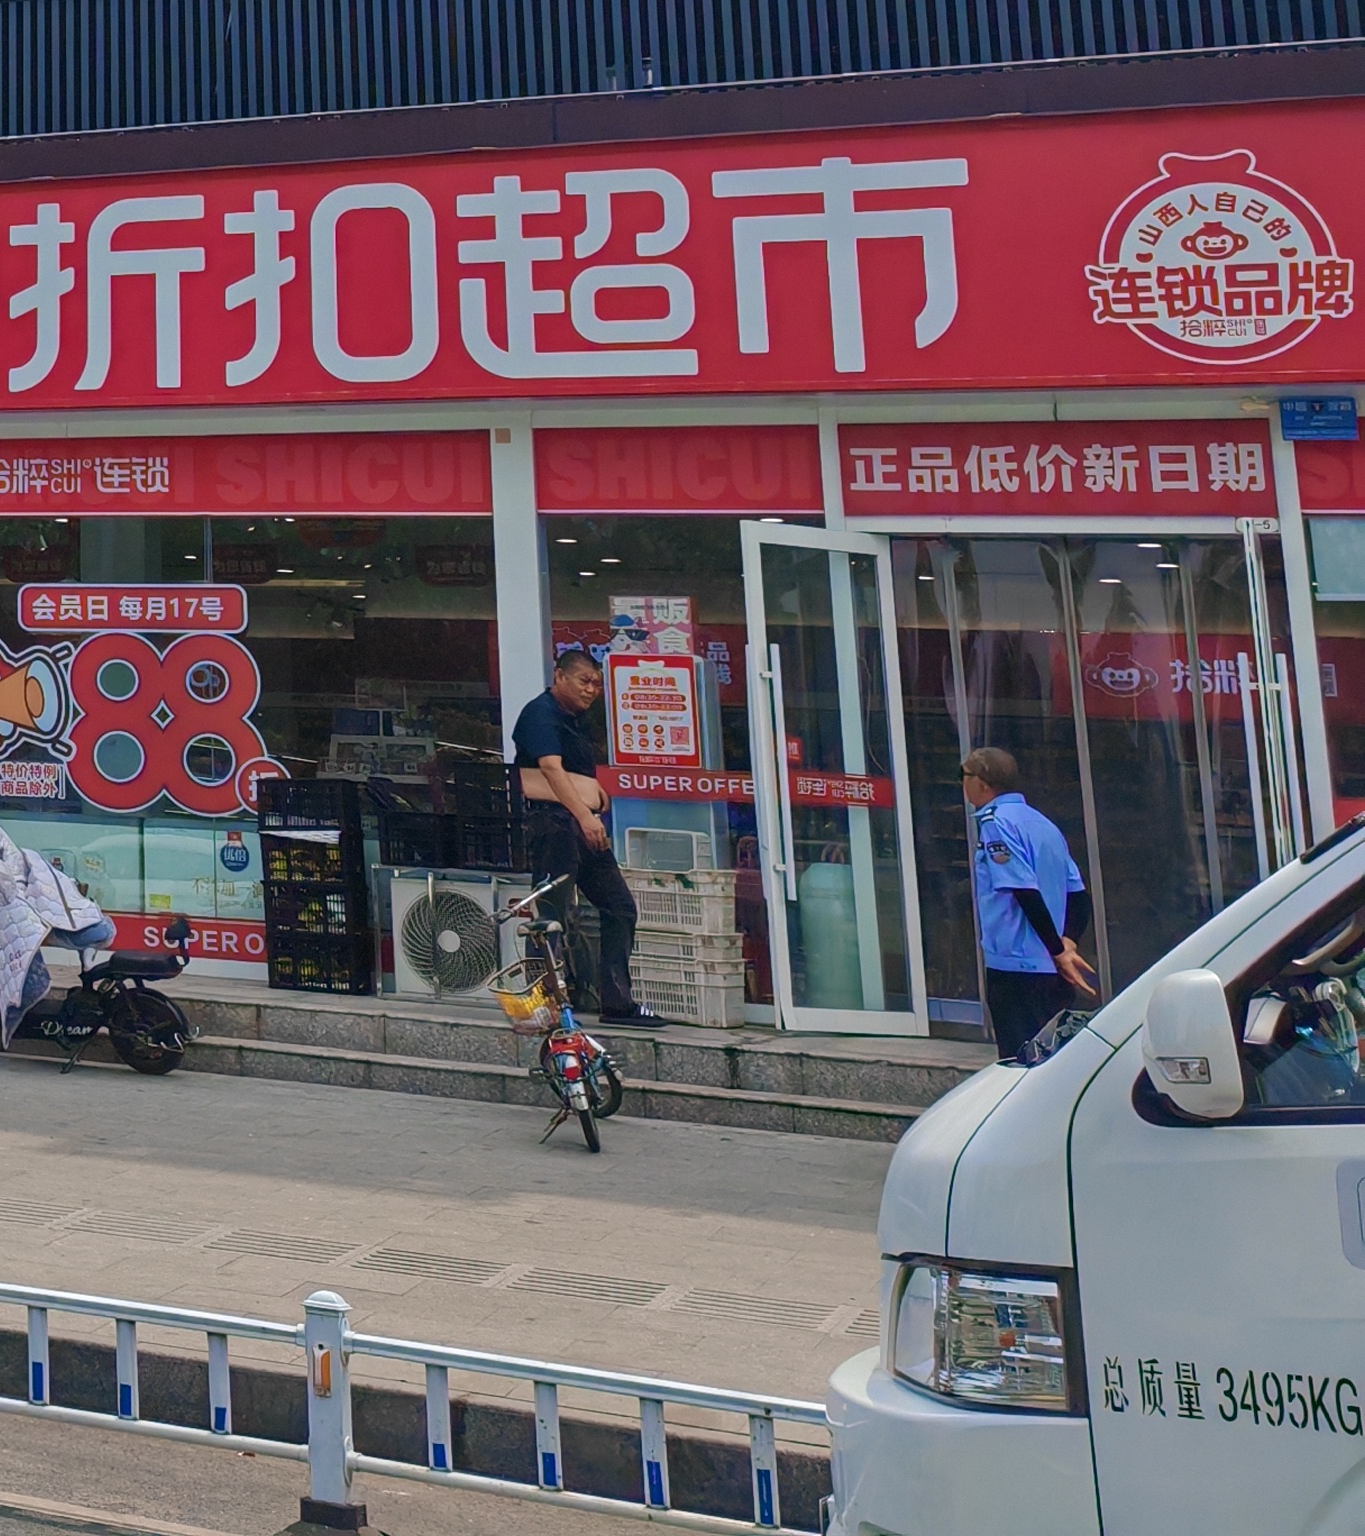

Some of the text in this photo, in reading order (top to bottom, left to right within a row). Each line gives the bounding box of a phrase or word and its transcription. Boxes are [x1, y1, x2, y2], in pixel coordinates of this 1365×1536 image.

[1138, 191, 1292, 247] 山西人自己的
[1086, 259, 1352, 320] 连锁品牌
[93, 456, 169, 494] 连锁
[849, 442, 1266, 494] 正品低价新日期
[32, 594, 224, 622] 会员日 每月17号
[68, 630, 264, 816] 88
[618, 773, 755, 797] SUPER OFFE
[1103, 1355, 1364, 1437] 总质量 3495KG
